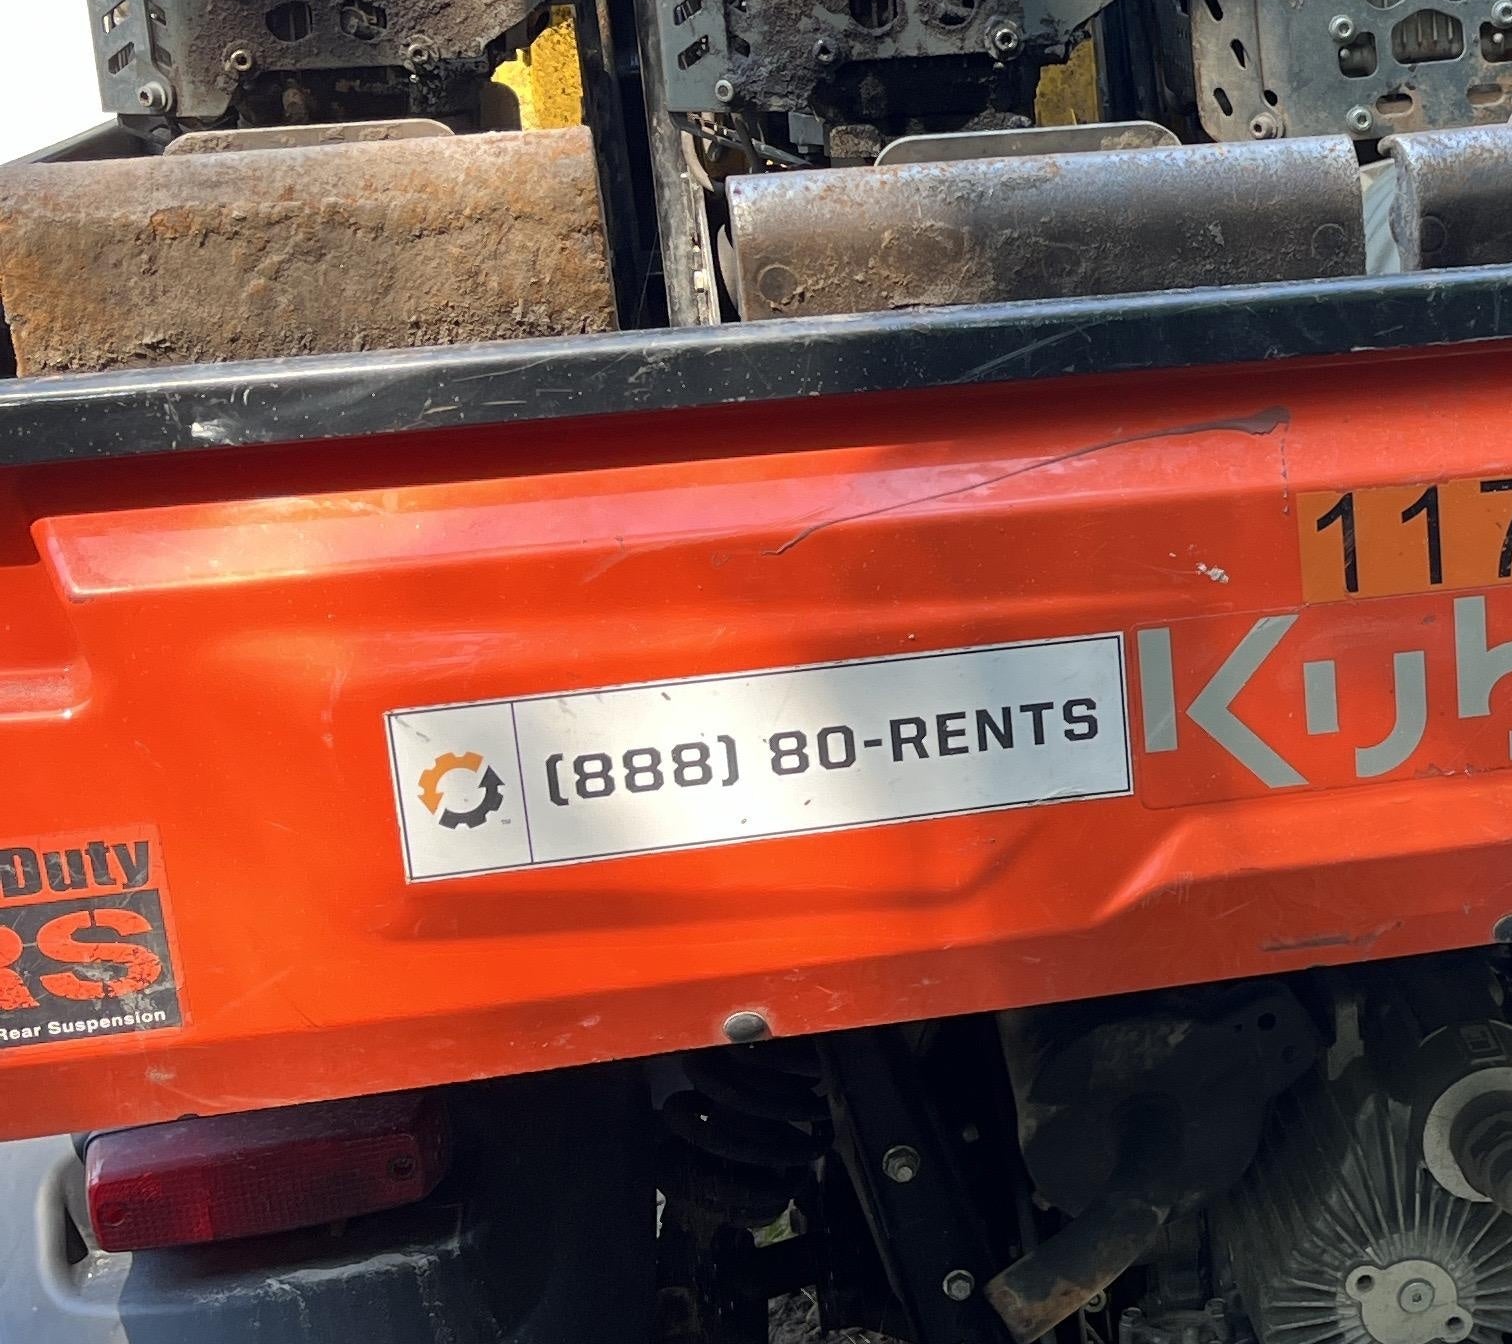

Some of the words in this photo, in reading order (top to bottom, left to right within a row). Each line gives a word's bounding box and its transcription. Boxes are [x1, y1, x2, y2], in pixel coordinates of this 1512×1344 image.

[546, 734, 739, 808] (888)
[769, 696, 1101, 778] 80-RENTS
[47, 1009, 166, 1035] Suspension
